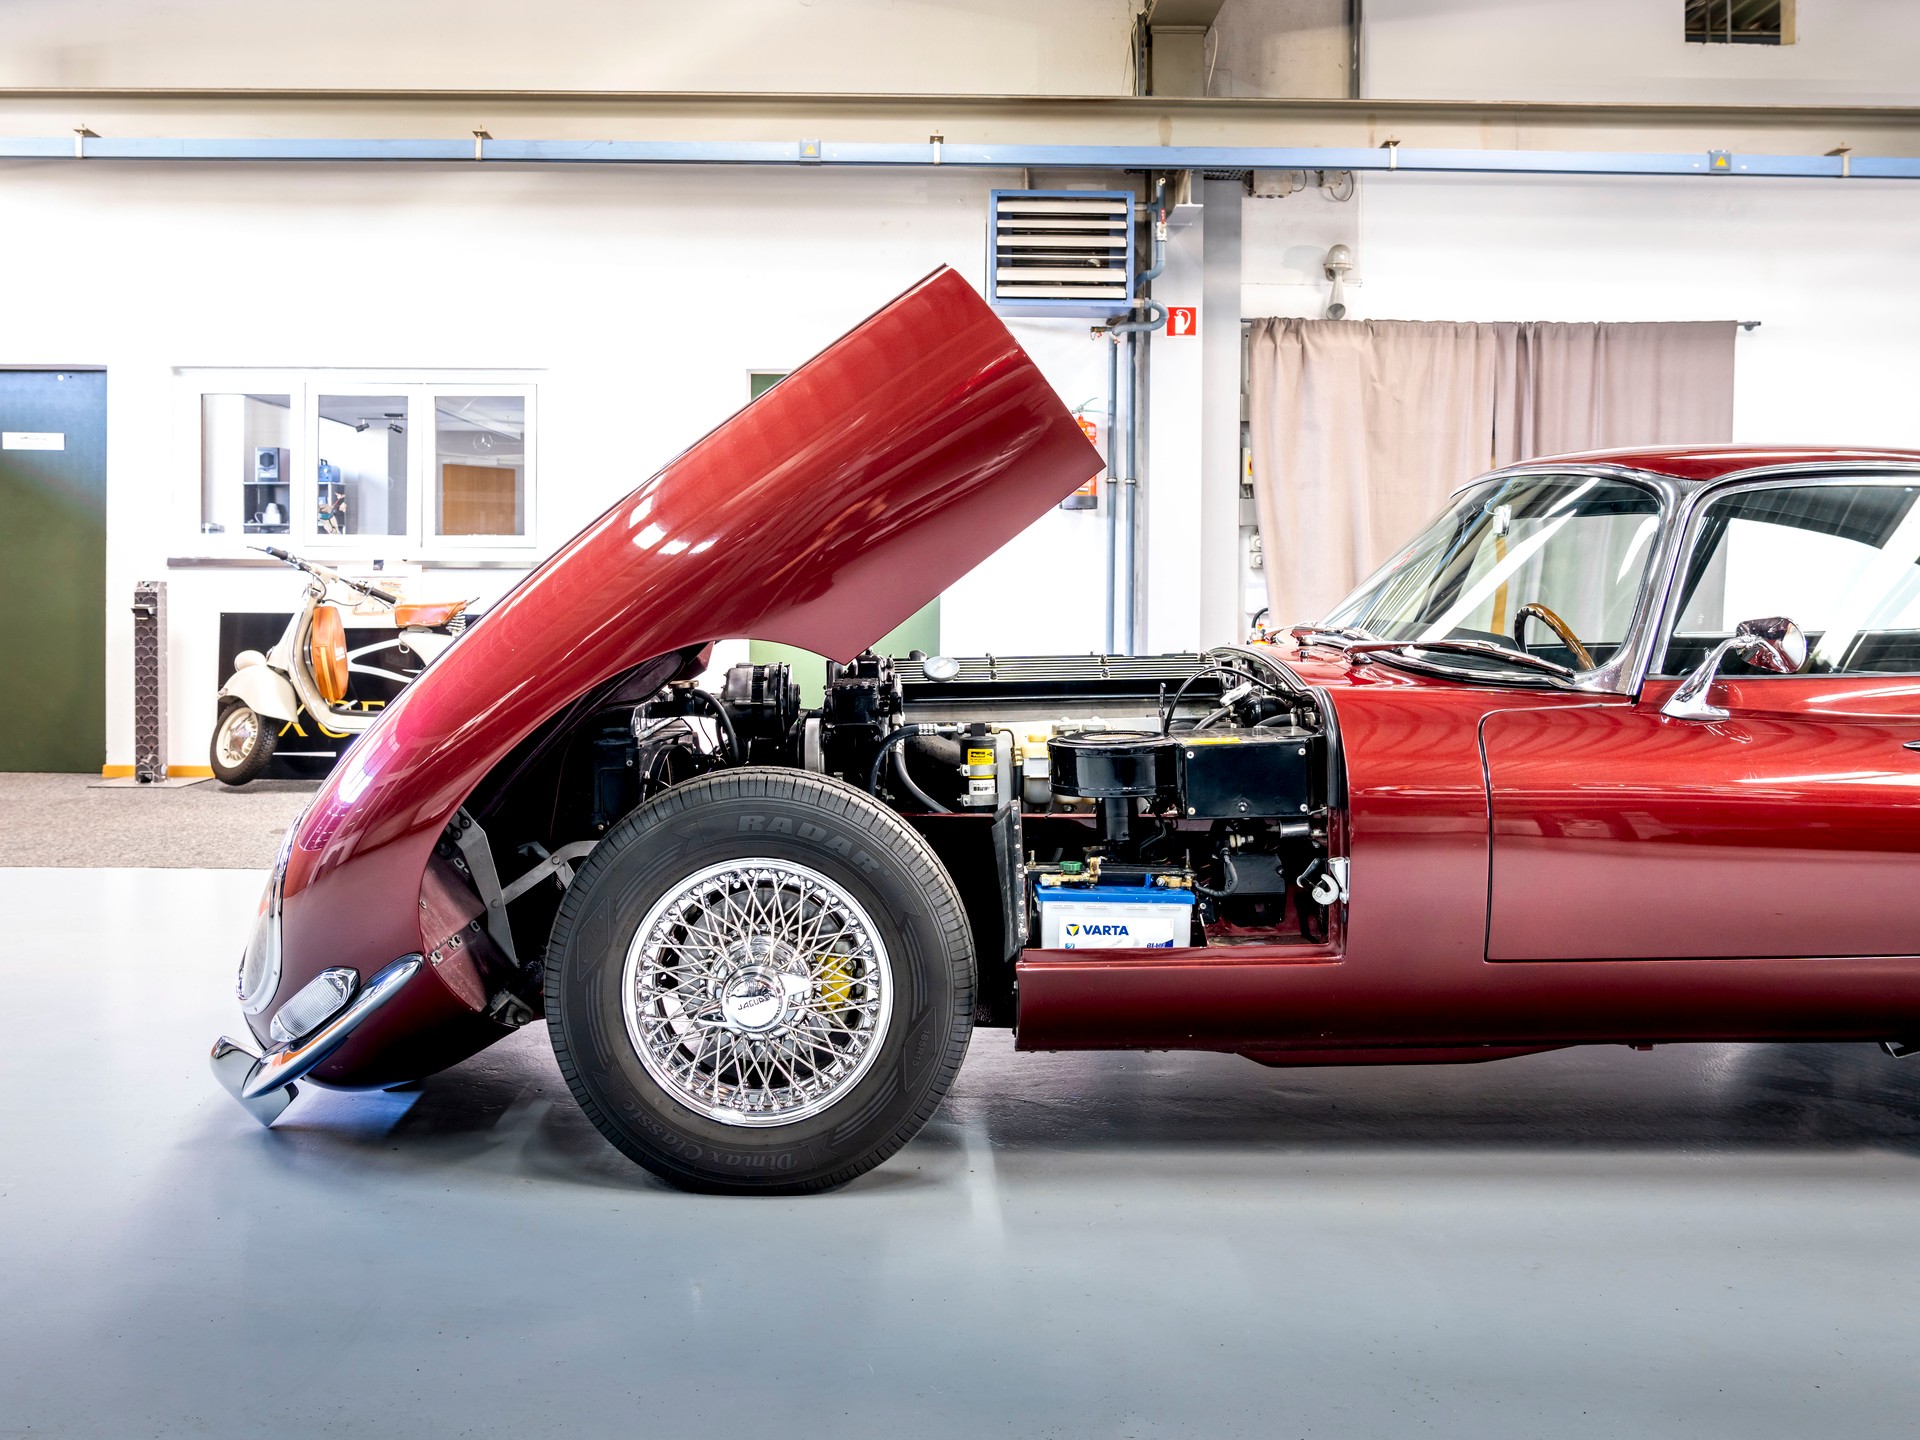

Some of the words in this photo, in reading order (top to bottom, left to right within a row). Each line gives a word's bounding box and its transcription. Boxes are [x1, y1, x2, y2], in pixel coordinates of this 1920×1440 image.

[738, 815, 880, 875] RADAR
[1083, 924, 1129, 936] VARTA
[737, 994, 771, 1010] JAGUAR
[622, 1100, 704, 1161] Classic
[706, 1150, 798, 1170] Dimax
